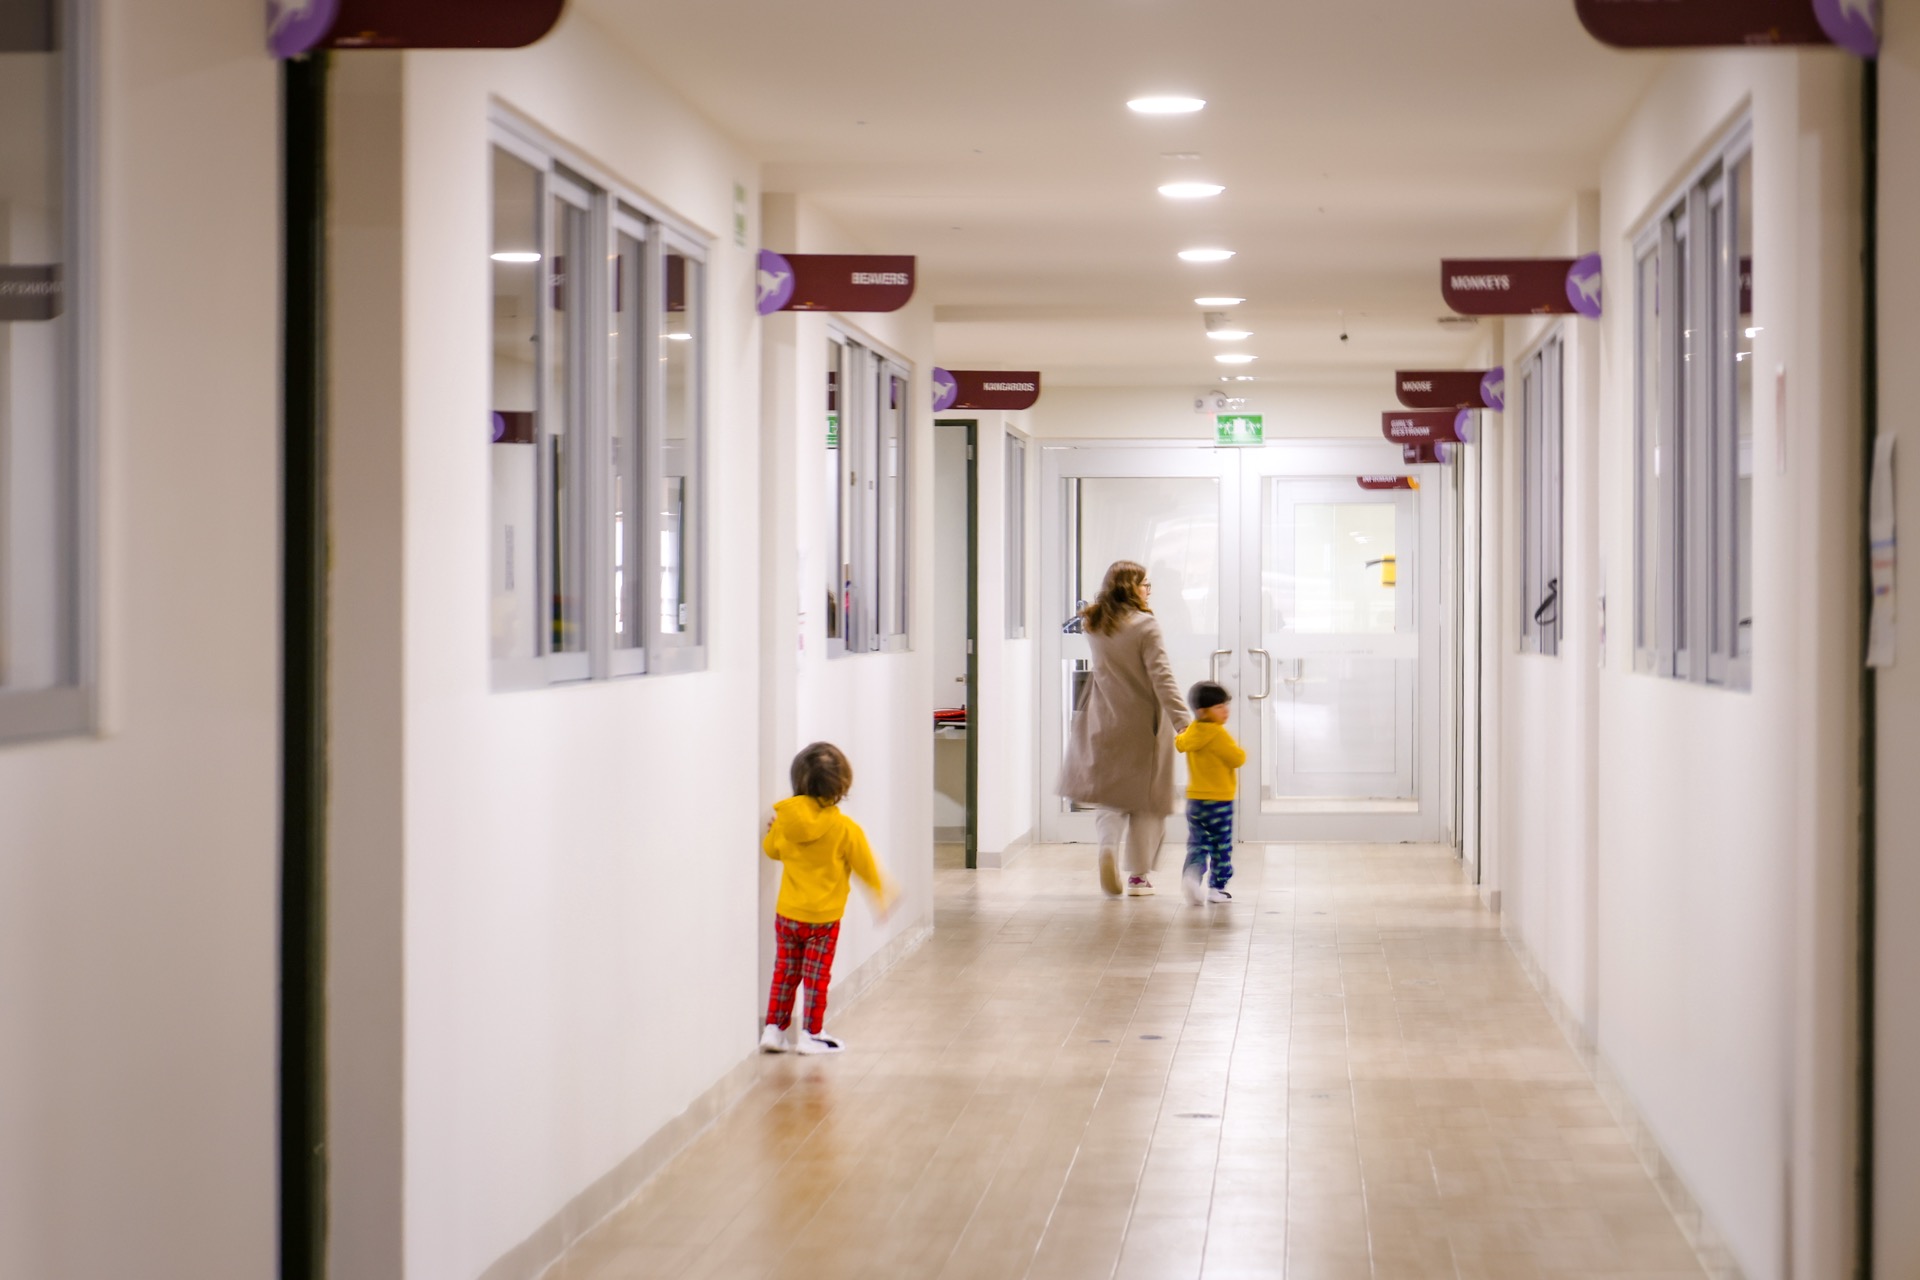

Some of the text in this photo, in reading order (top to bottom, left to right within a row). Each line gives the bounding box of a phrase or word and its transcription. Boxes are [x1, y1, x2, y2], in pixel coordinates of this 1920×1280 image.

[851, 272, 908, 285] BEAVERS
[1451, 275, 1510, 290] MONKEYS
[983, 382, 1035, 391] KANGAROOS
[1402, 381, 1432, 392] MOOSE
[1390, 427, 1430, 436] RESTROOM
